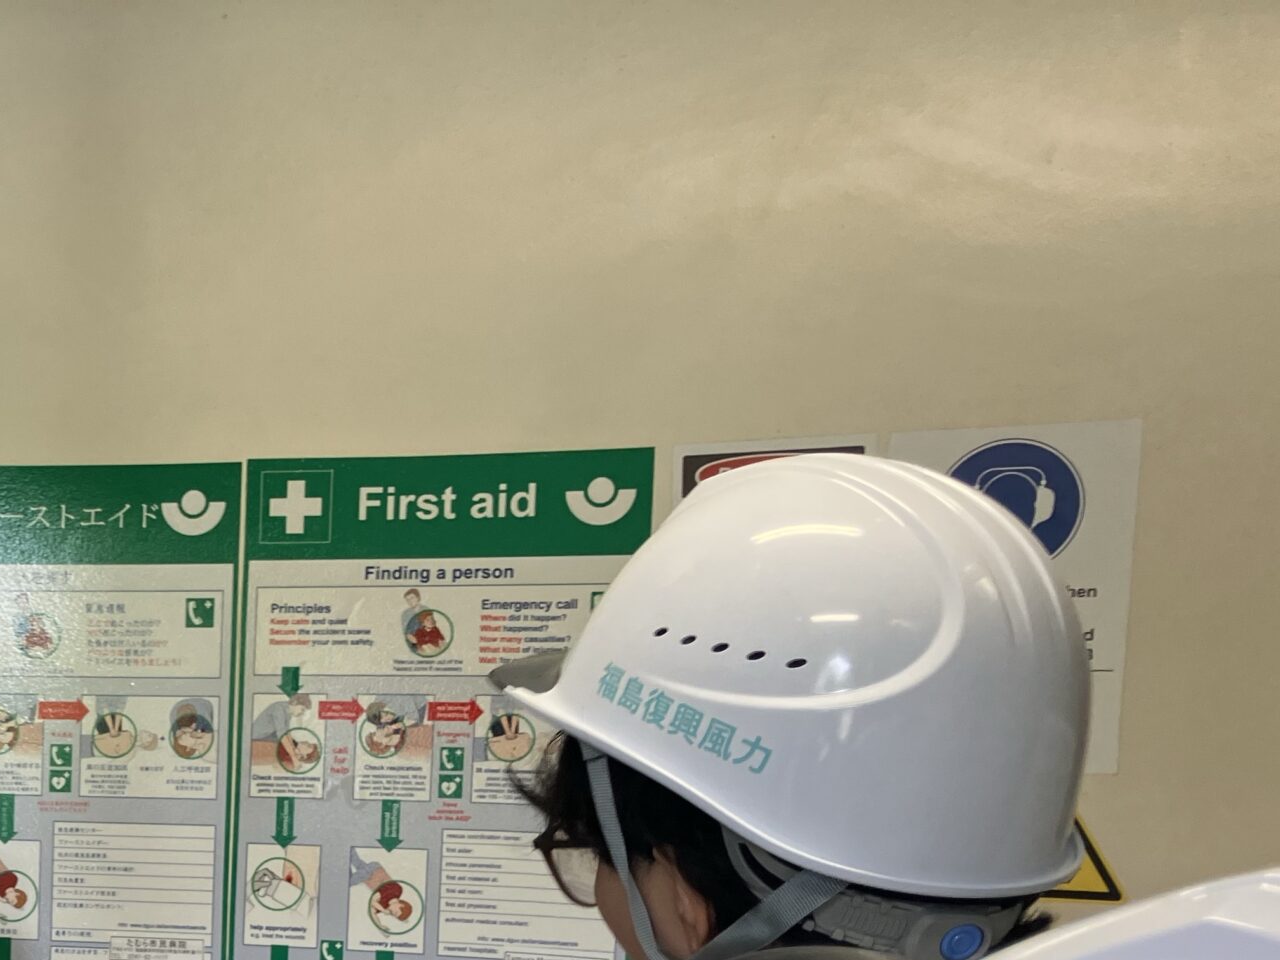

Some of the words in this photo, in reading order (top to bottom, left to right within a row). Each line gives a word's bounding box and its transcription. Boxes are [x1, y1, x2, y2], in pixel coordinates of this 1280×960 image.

[358, 485, 457, 521] First
[470, 482, 538, 519] aid
[364, 566, 431, 583] Finding
[436, 569, 447, 580] a
[451, 565, 515, 582] person
[271, 603, 332, 615] Principles
[481, 598, 553, 612] Emergency
[556, 598, 579, 610] call
[597, 660, 774, 774] 福島復興風力
